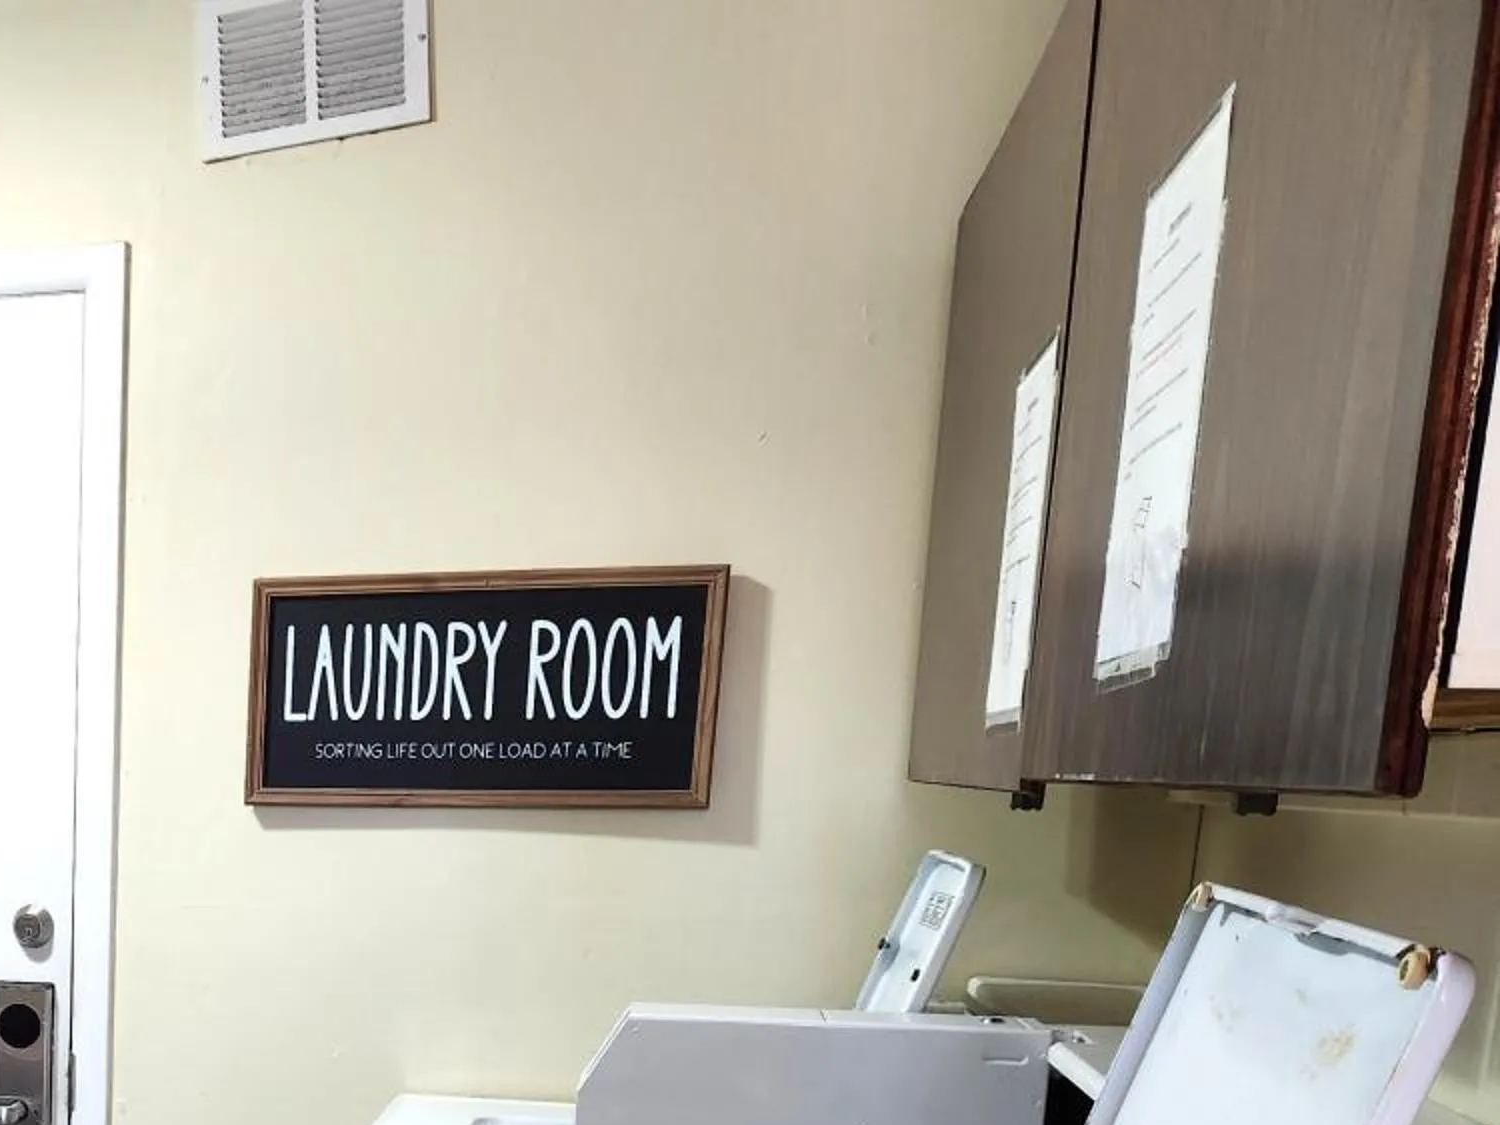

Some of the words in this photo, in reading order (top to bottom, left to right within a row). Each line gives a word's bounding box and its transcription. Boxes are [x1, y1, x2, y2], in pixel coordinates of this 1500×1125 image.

[283, 619, 508, 722] LAUNDRY
[525, 615, 683, 721] ROOM
[315, 743, 383, 759] SORTING
[387, 743, 418, 759] LIFE
[421, 743, 455, 759] OUT
[459, 743, 495, 759] ONE
[499, 743, 546, 759] LOAD
[550, 743, 573, 759] AT
[575, 743, 588, 759] A
[592, 741, 633, 759] TIME
